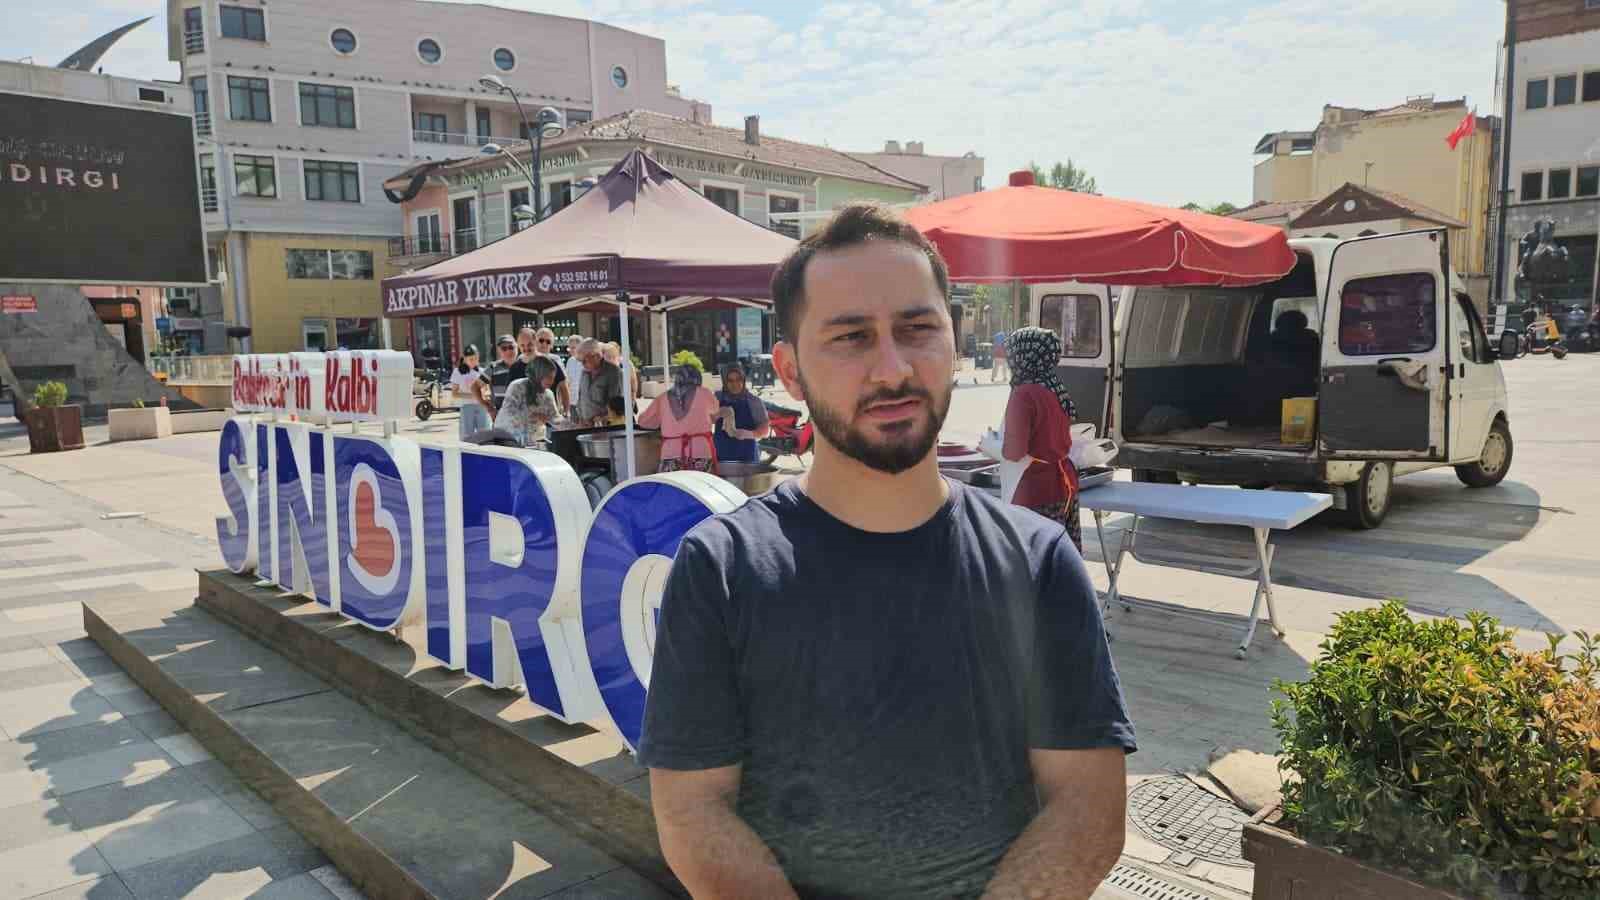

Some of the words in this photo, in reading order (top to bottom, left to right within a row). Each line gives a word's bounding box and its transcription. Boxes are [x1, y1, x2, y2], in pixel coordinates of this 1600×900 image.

[0, 162, 120, 190] DIRGI
[387, 280, 459, 312] AKPINAR
[463, 272, 535, 302] YEMEK
[325, 356, 378, 415] Kalbi
